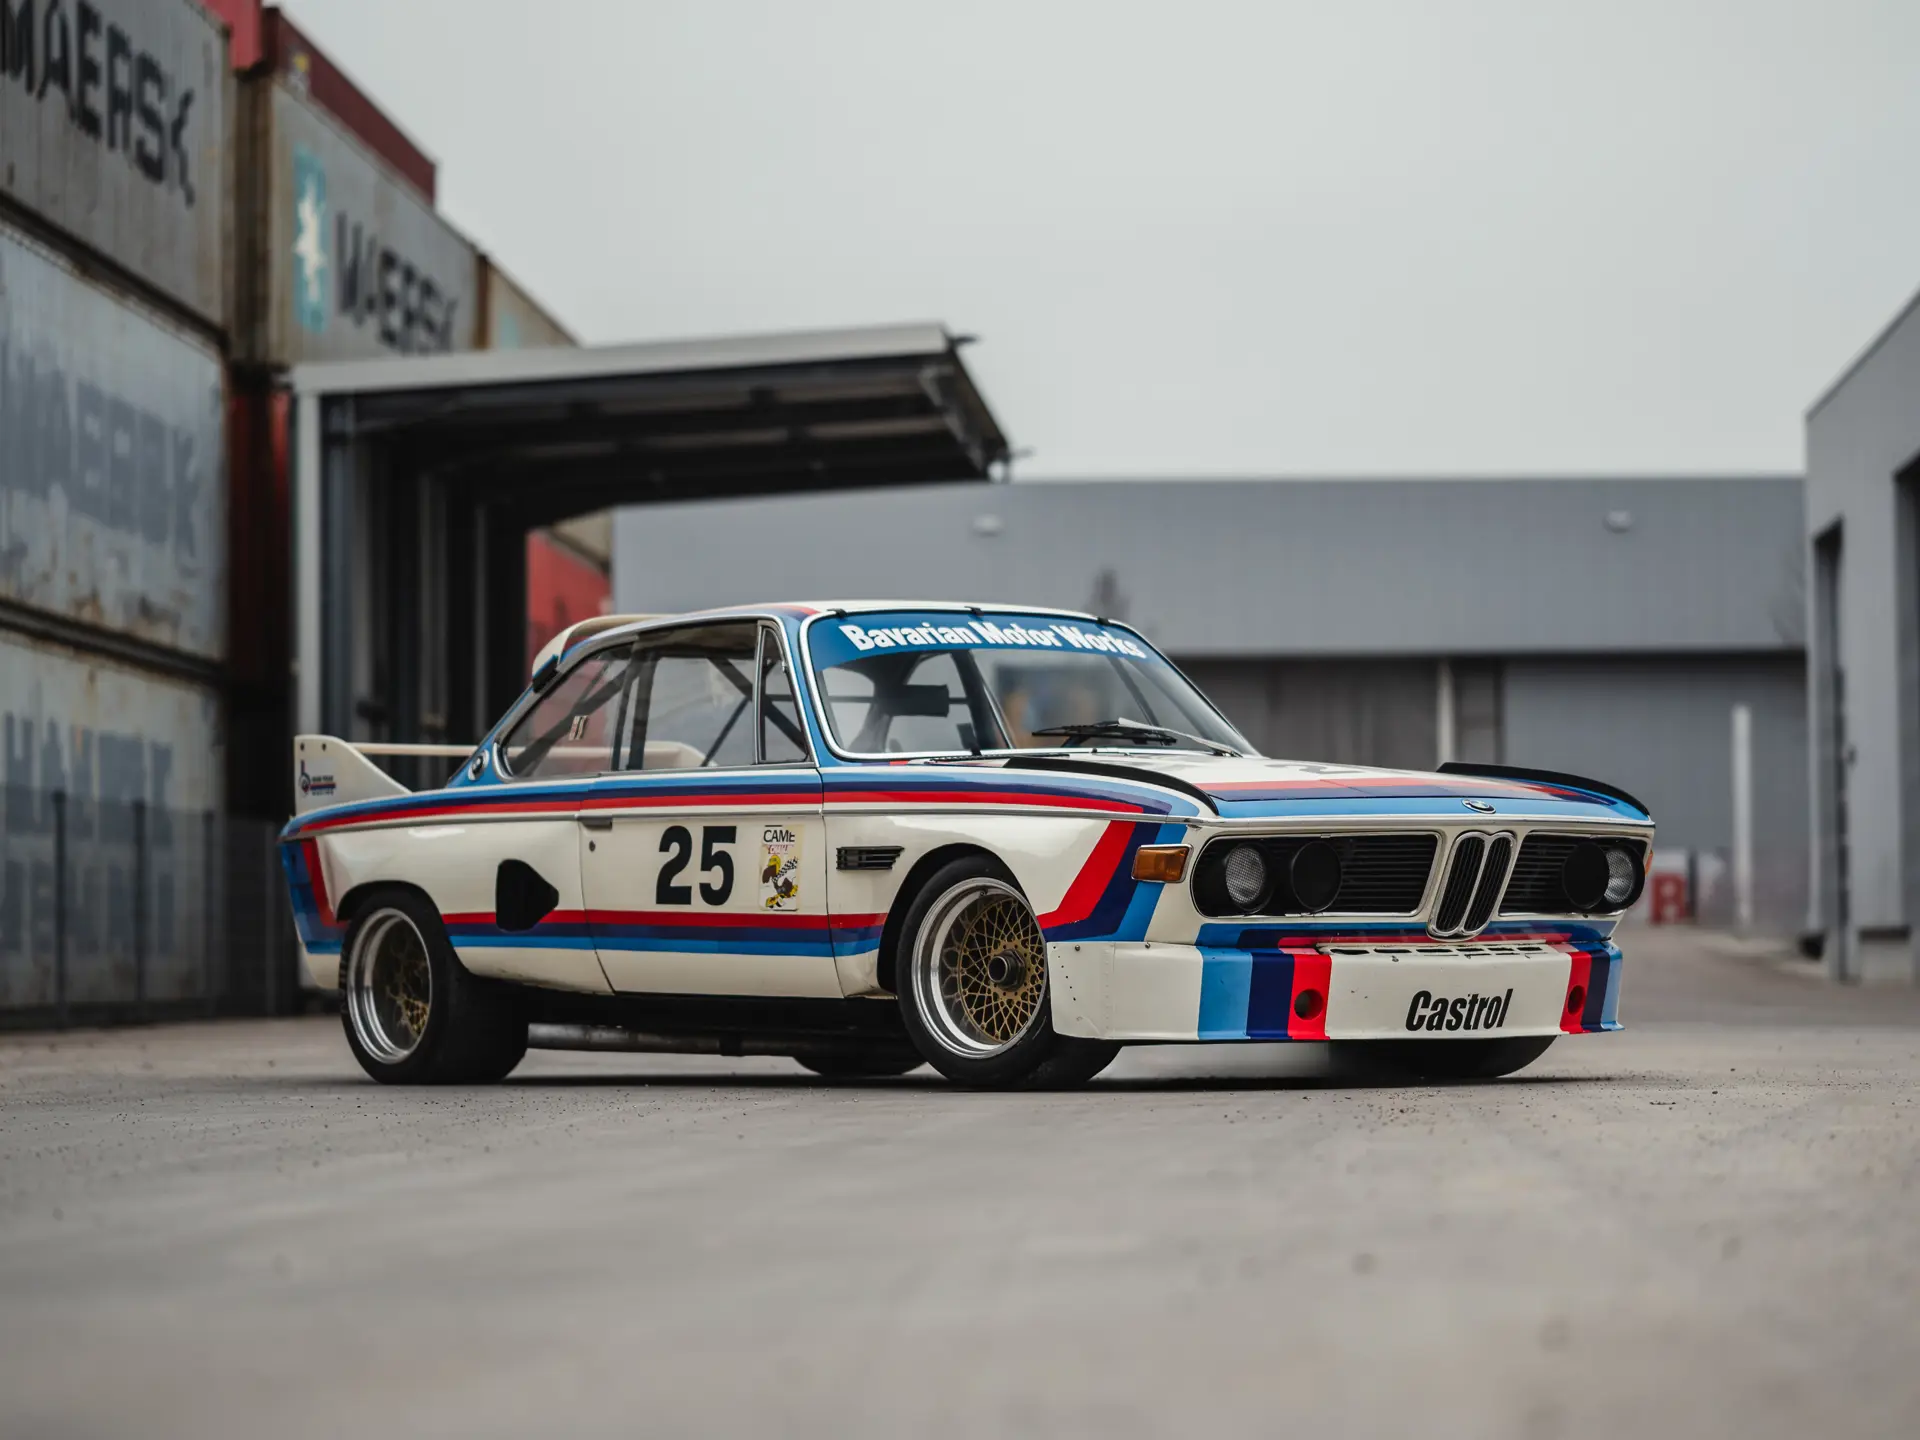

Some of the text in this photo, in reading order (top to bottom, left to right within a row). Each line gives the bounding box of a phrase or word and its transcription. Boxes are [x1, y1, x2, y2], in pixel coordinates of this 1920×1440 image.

[838, 621, 1146, 659] Bavarian Motor Works
[656, 825, 737, 906] 25
[1405, 988, 1514, 1031] Castrol
